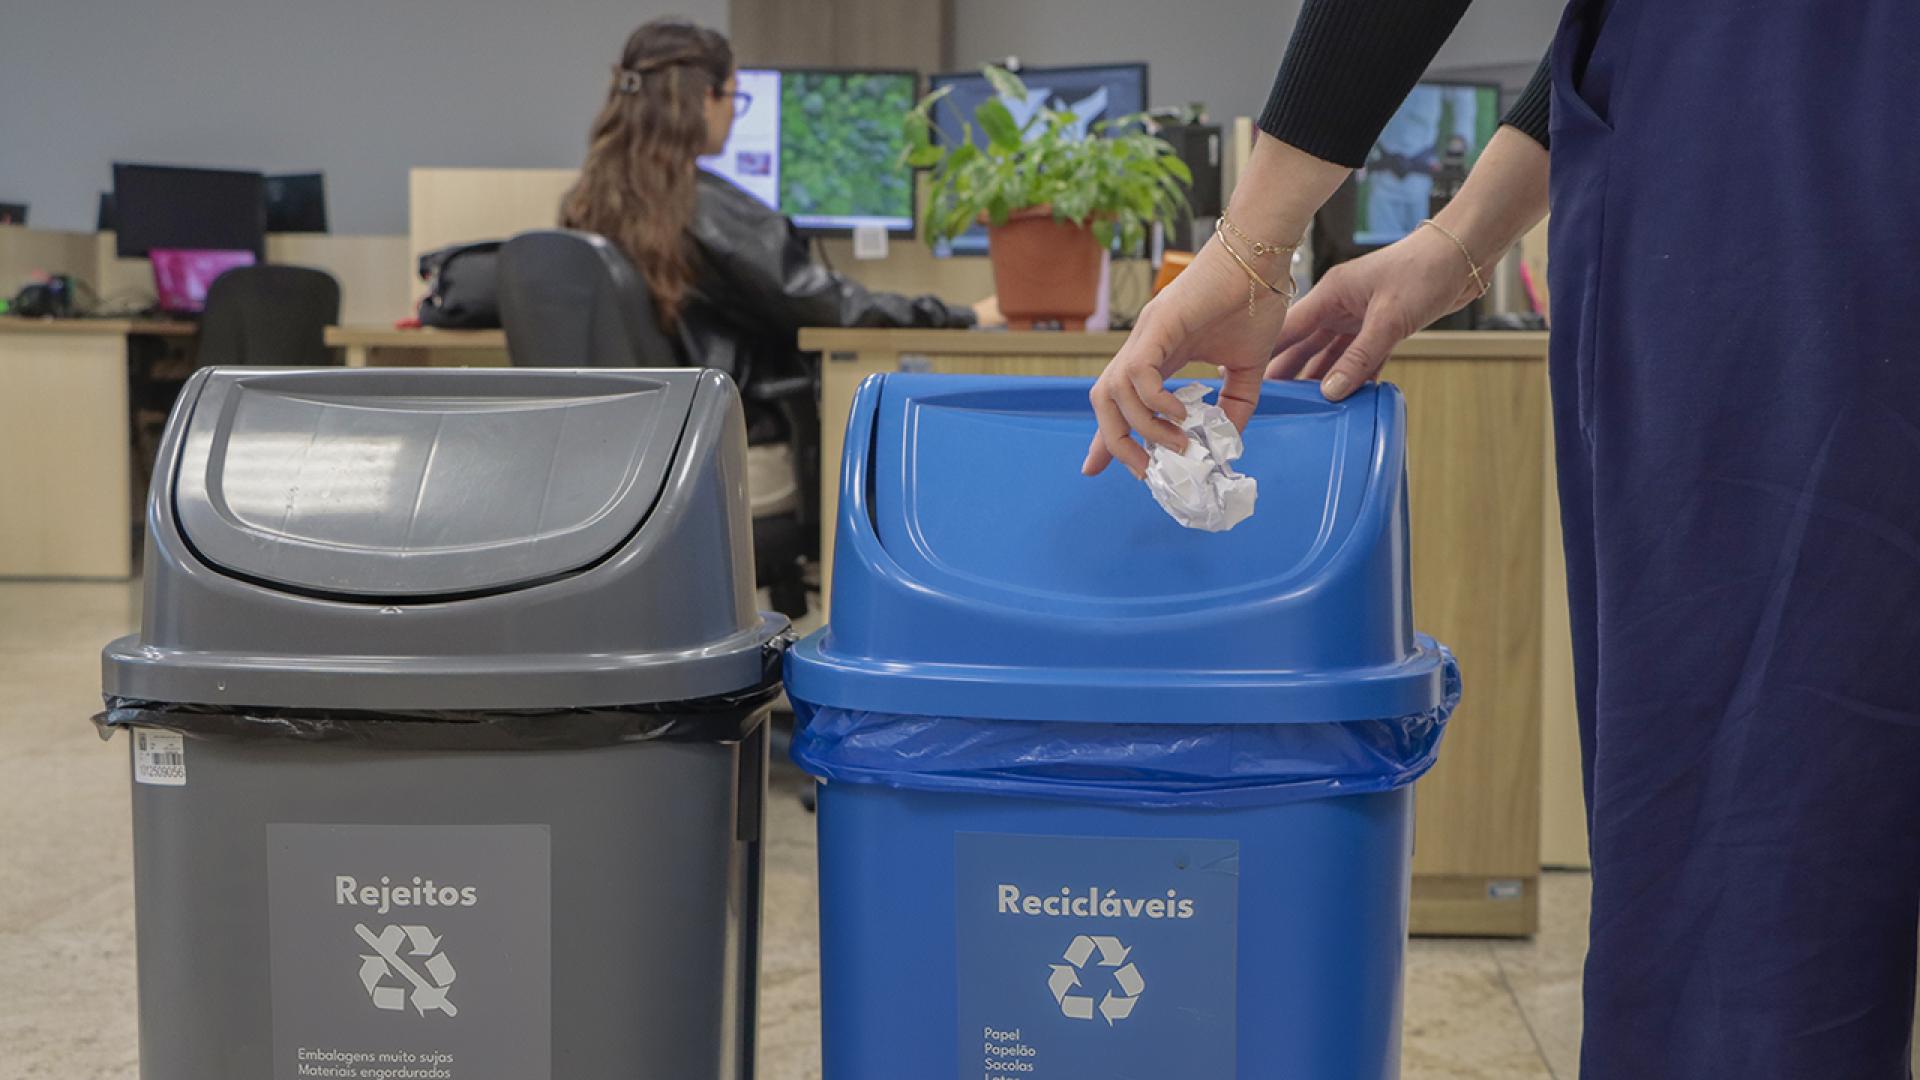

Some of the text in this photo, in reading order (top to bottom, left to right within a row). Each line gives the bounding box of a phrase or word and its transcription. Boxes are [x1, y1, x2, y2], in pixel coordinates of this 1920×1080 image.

[335, 875, 478, 914] Rejeitos
[998, 884, 1194, 918] Recicláveis
[984, 1027, 1019, 1042] Papel
[298, 1048, 453, 1065] Embalagens muito sujas
[984, 1042, 1036, 1058] Papelão
[298, 1064, 451, 1080] Materiais engordurados
[985, 1057, 1033, 1071] Sacolas
